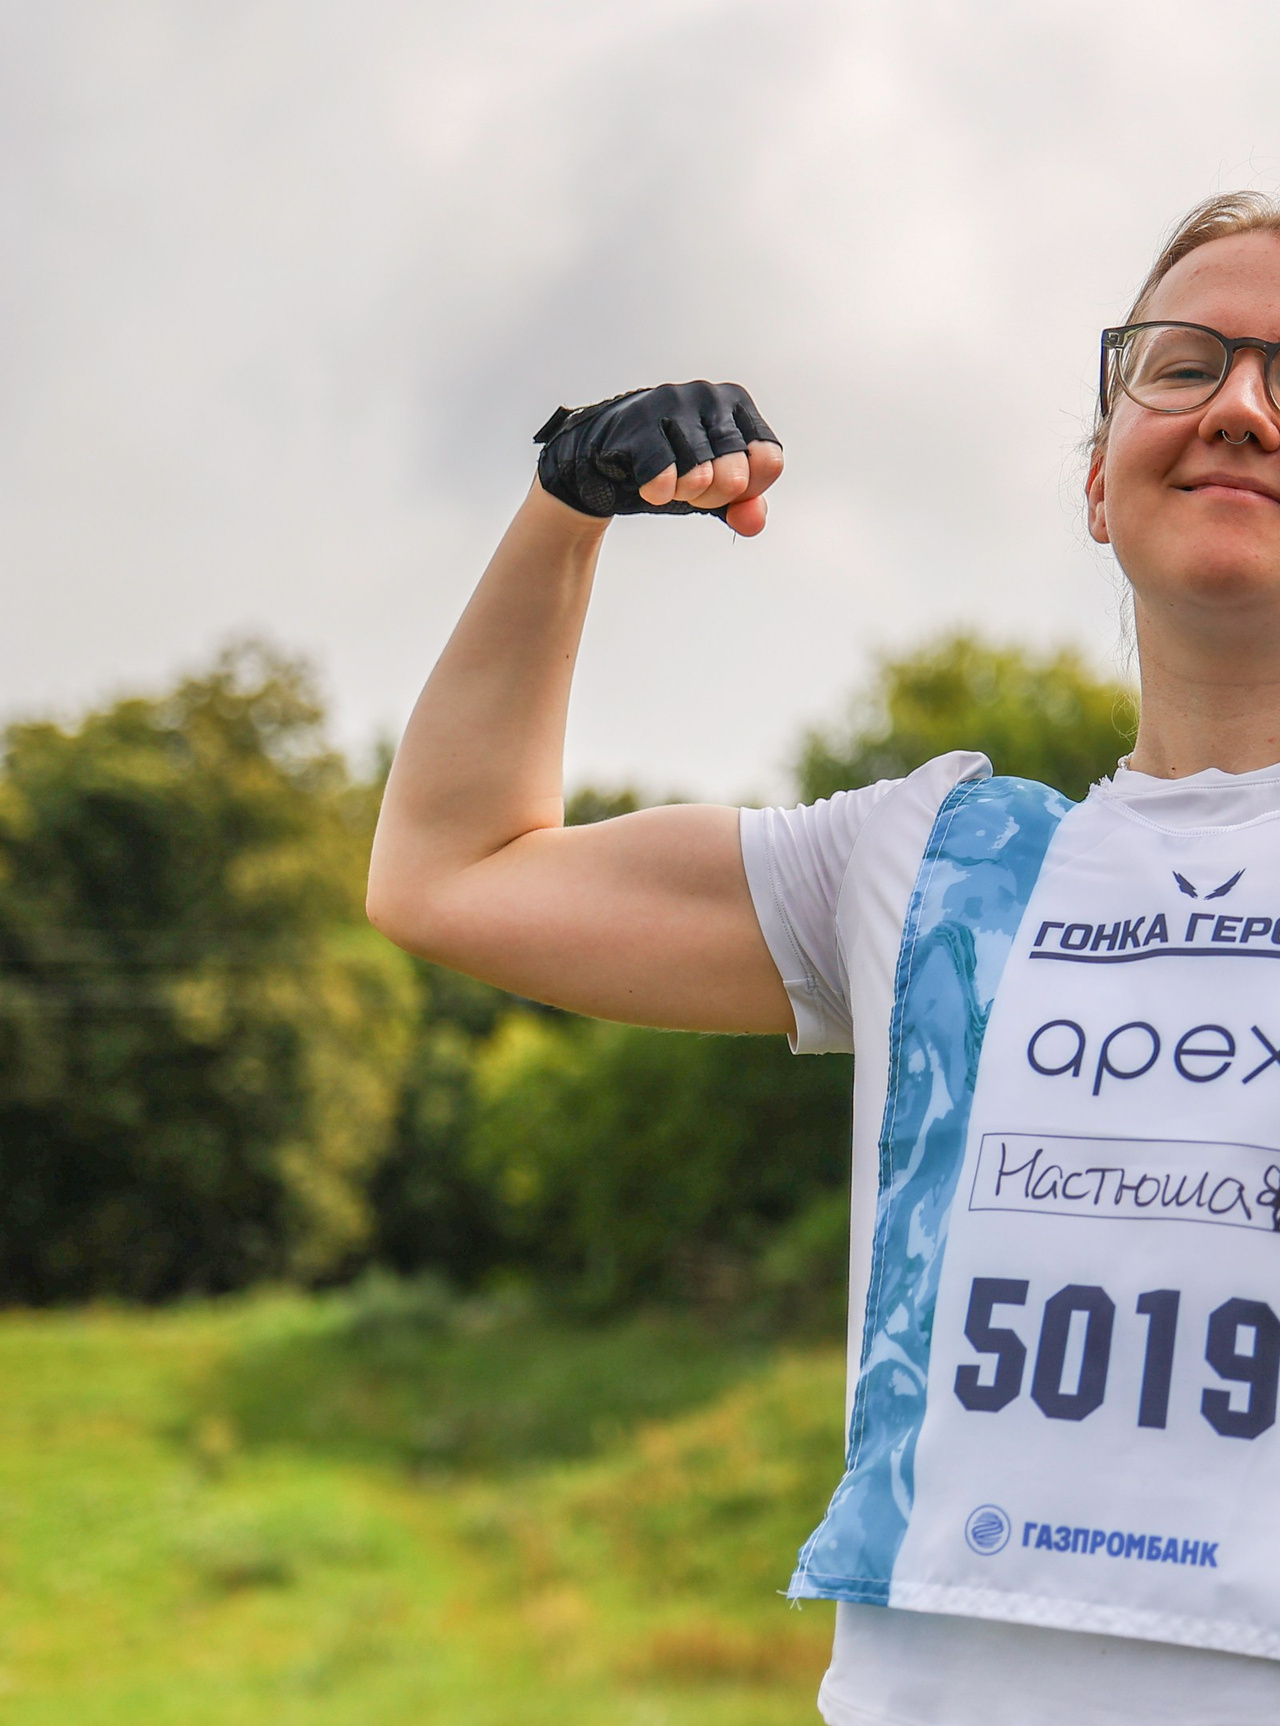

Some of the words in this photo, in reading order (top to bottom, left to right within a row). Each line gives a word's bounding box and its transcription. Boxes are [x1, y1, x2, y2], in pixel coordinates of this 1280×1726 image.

[1033, 913, 1169, 952] ГОНКА
[995, 1142, 1252, 1220] Настюша
[1021, 1521, 1220, 1568] ГАЗПРОМБАНК
